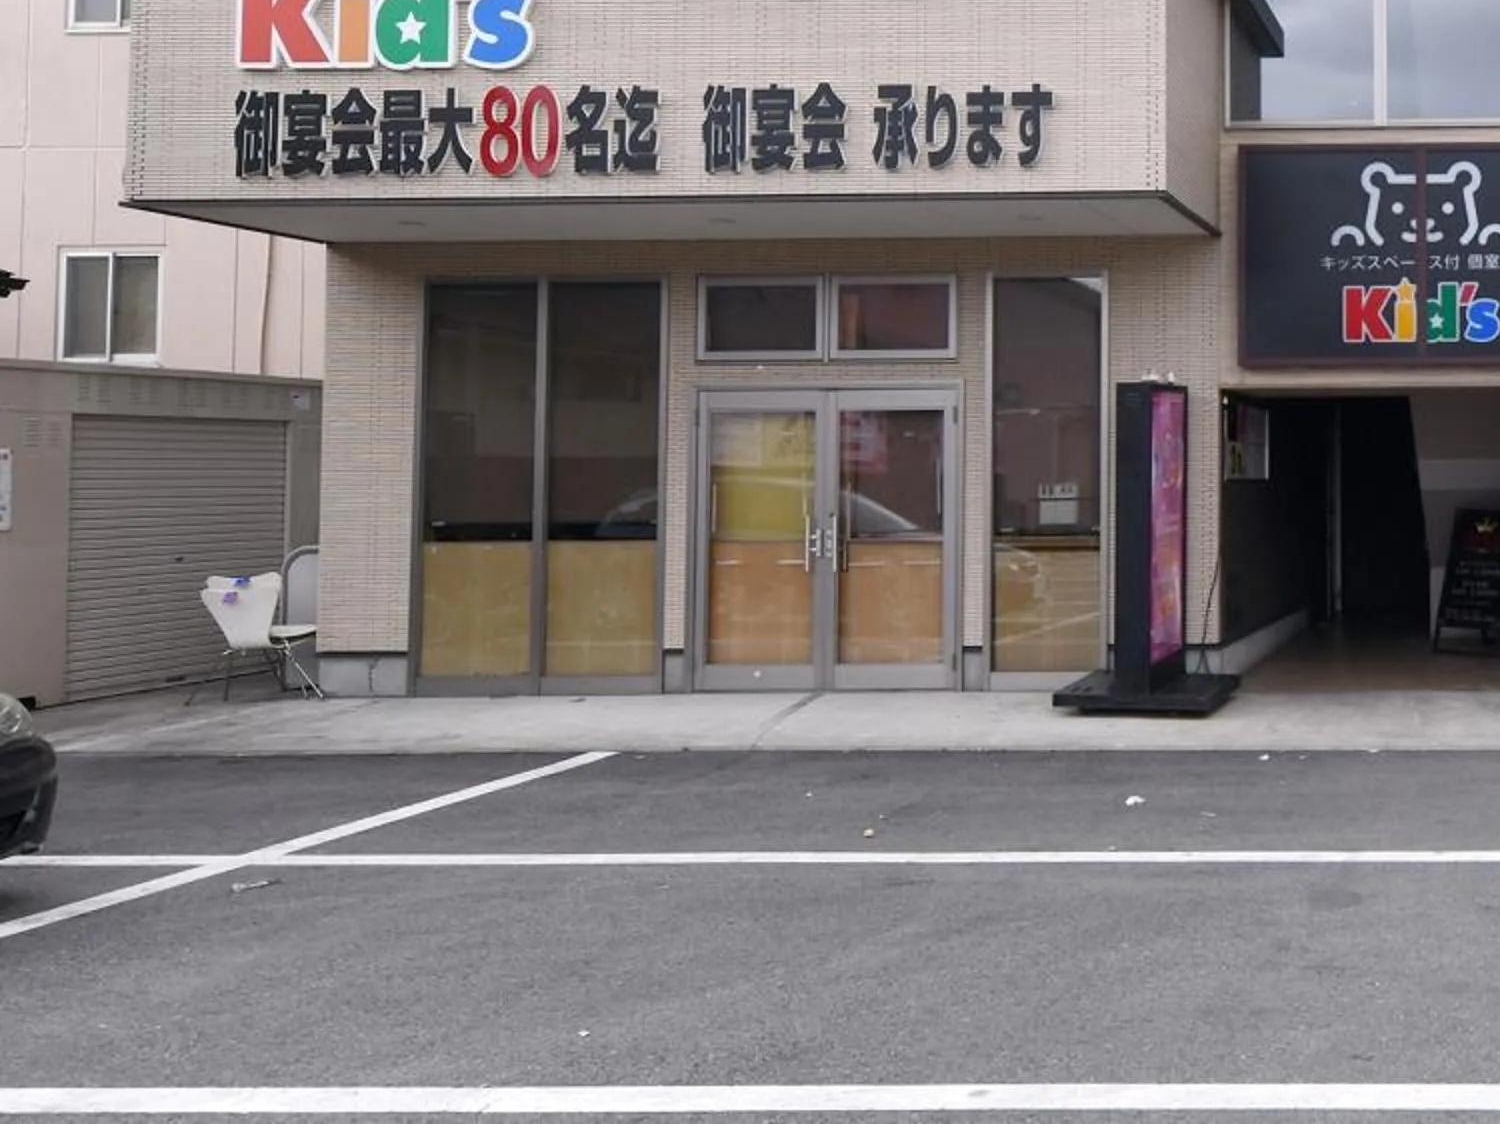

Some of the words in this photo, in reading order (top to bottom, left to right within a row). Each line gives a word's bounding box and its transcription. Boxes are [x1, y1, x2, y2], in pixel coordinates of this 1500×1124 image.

[234, 84, 662, 179] 御宴会最大80名迄
[702, 84, 848, 174] 御宴会
[872, 82, 1054, 170] 承ります
